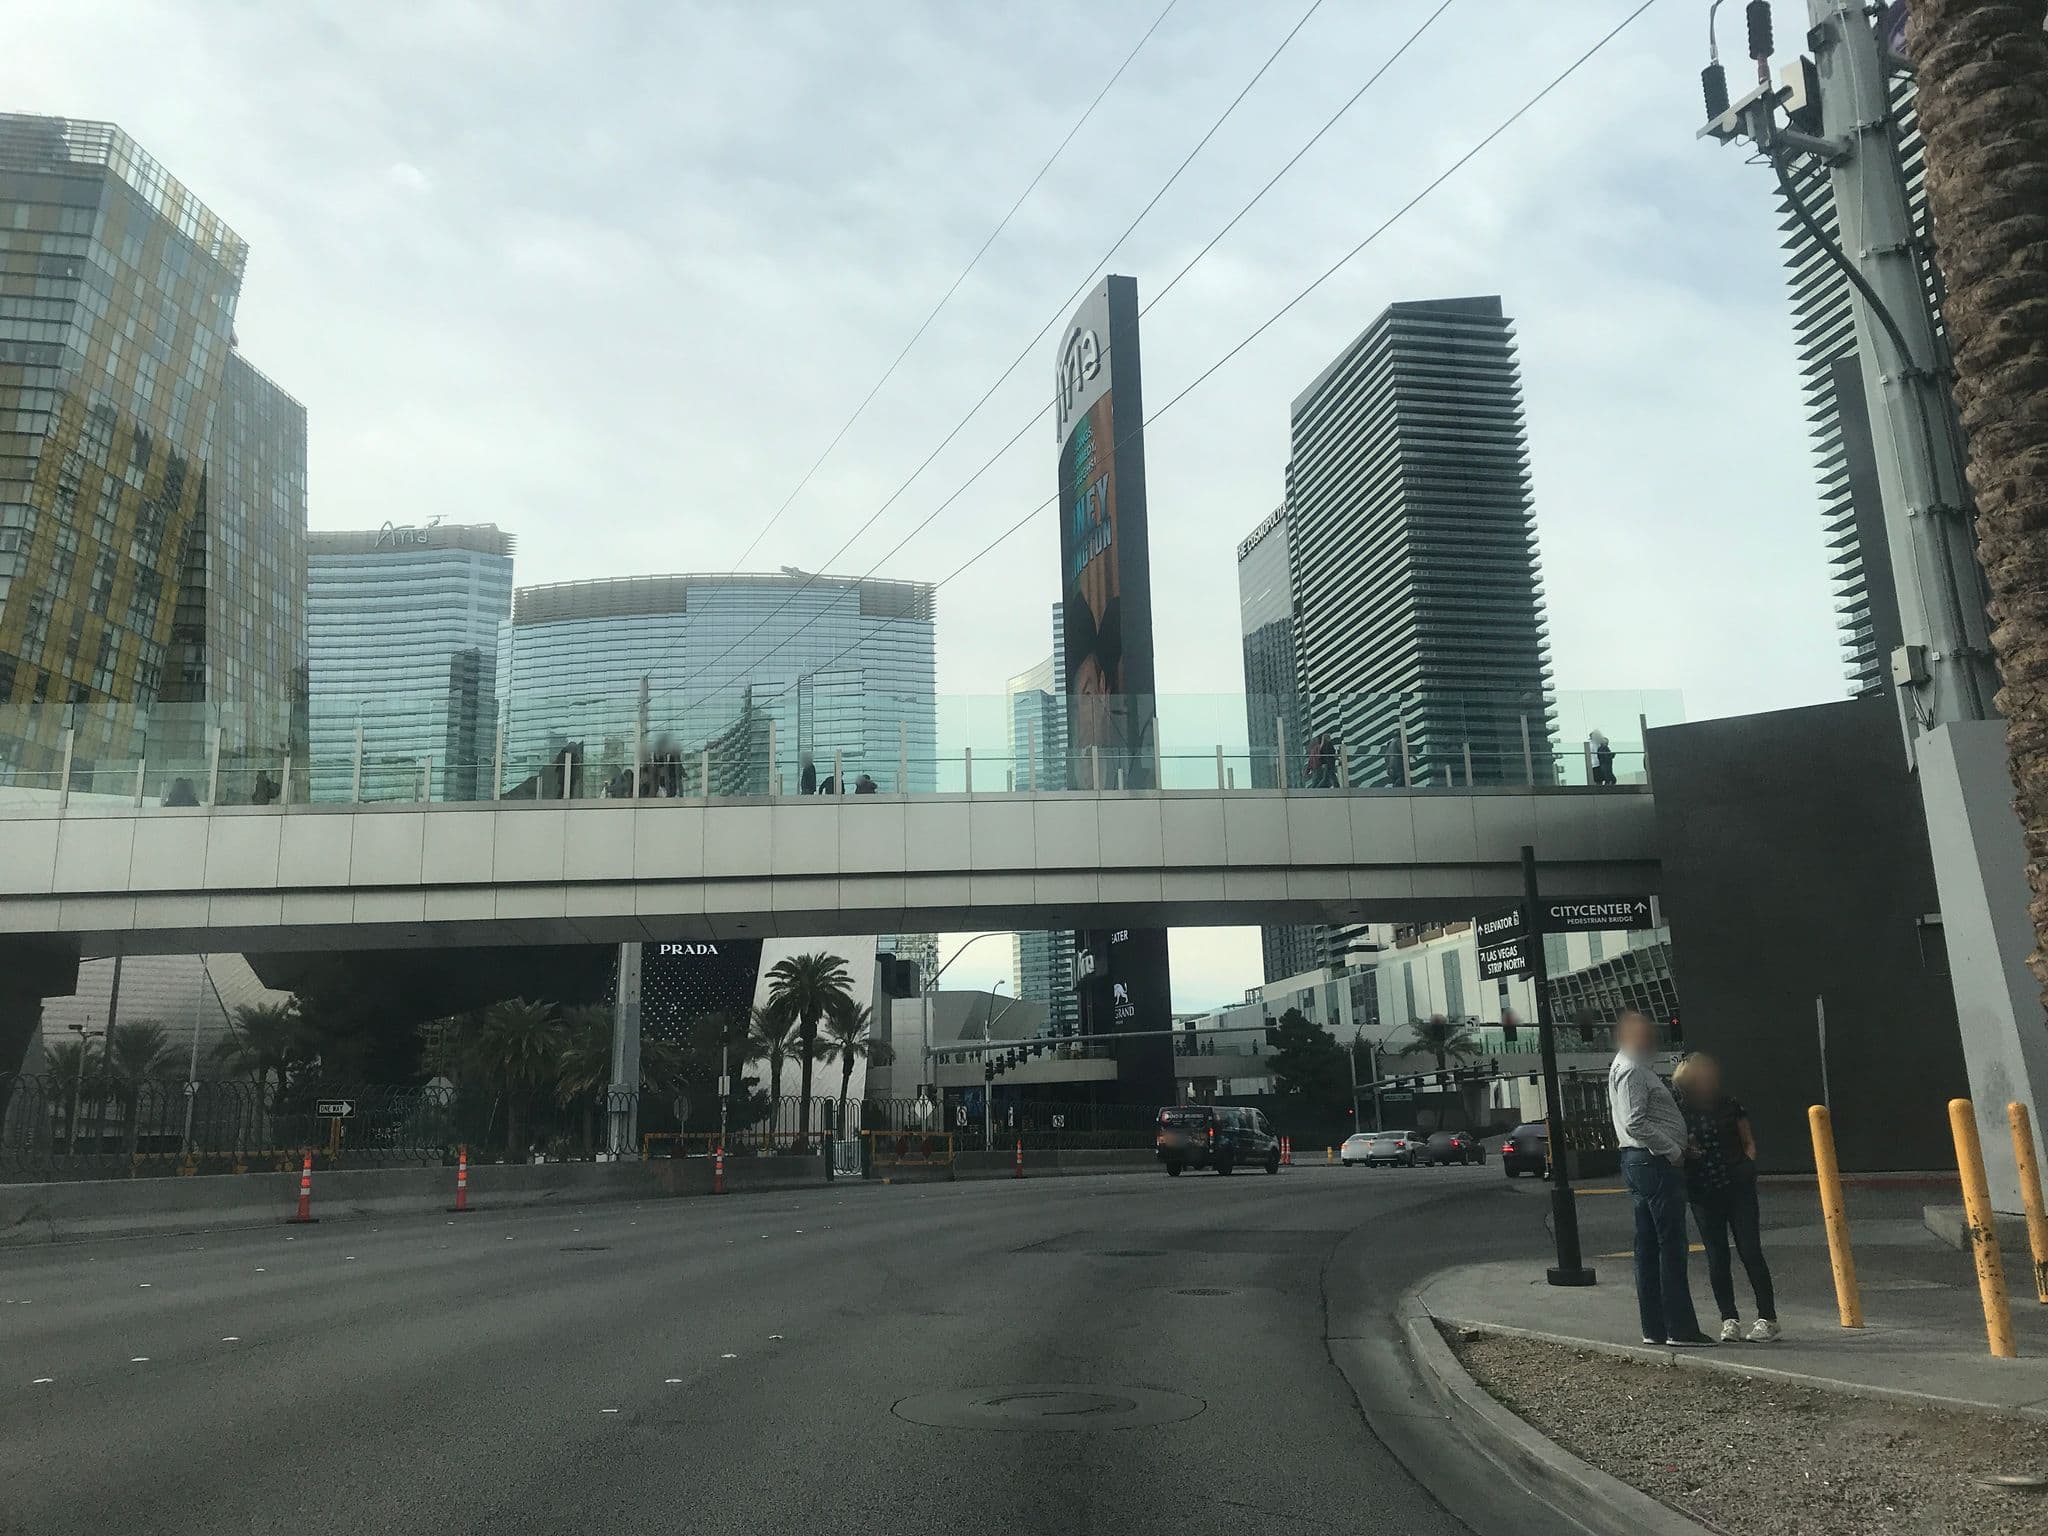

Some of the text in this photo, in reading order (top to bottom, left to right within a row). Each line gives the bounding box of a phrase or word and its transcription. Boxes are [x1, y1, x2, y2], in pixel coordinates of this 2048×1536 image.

[375, 520, 429, 548] Aria
[1247, 503, 1287, 552] COSMOPOLITA
[1550, 903, 1632, 917] CITYCENTER
[1484, 916, 1513, 934] ELEVATOR
[1567, 916, 1634, 925] PEDESTRIAN BRIDGE
[660, 944, 719, 955] PRADA
[1486, 945, 1518, 962] LAS VEGAS
[1487, 956, 1526, 974] STRIP NORTH
